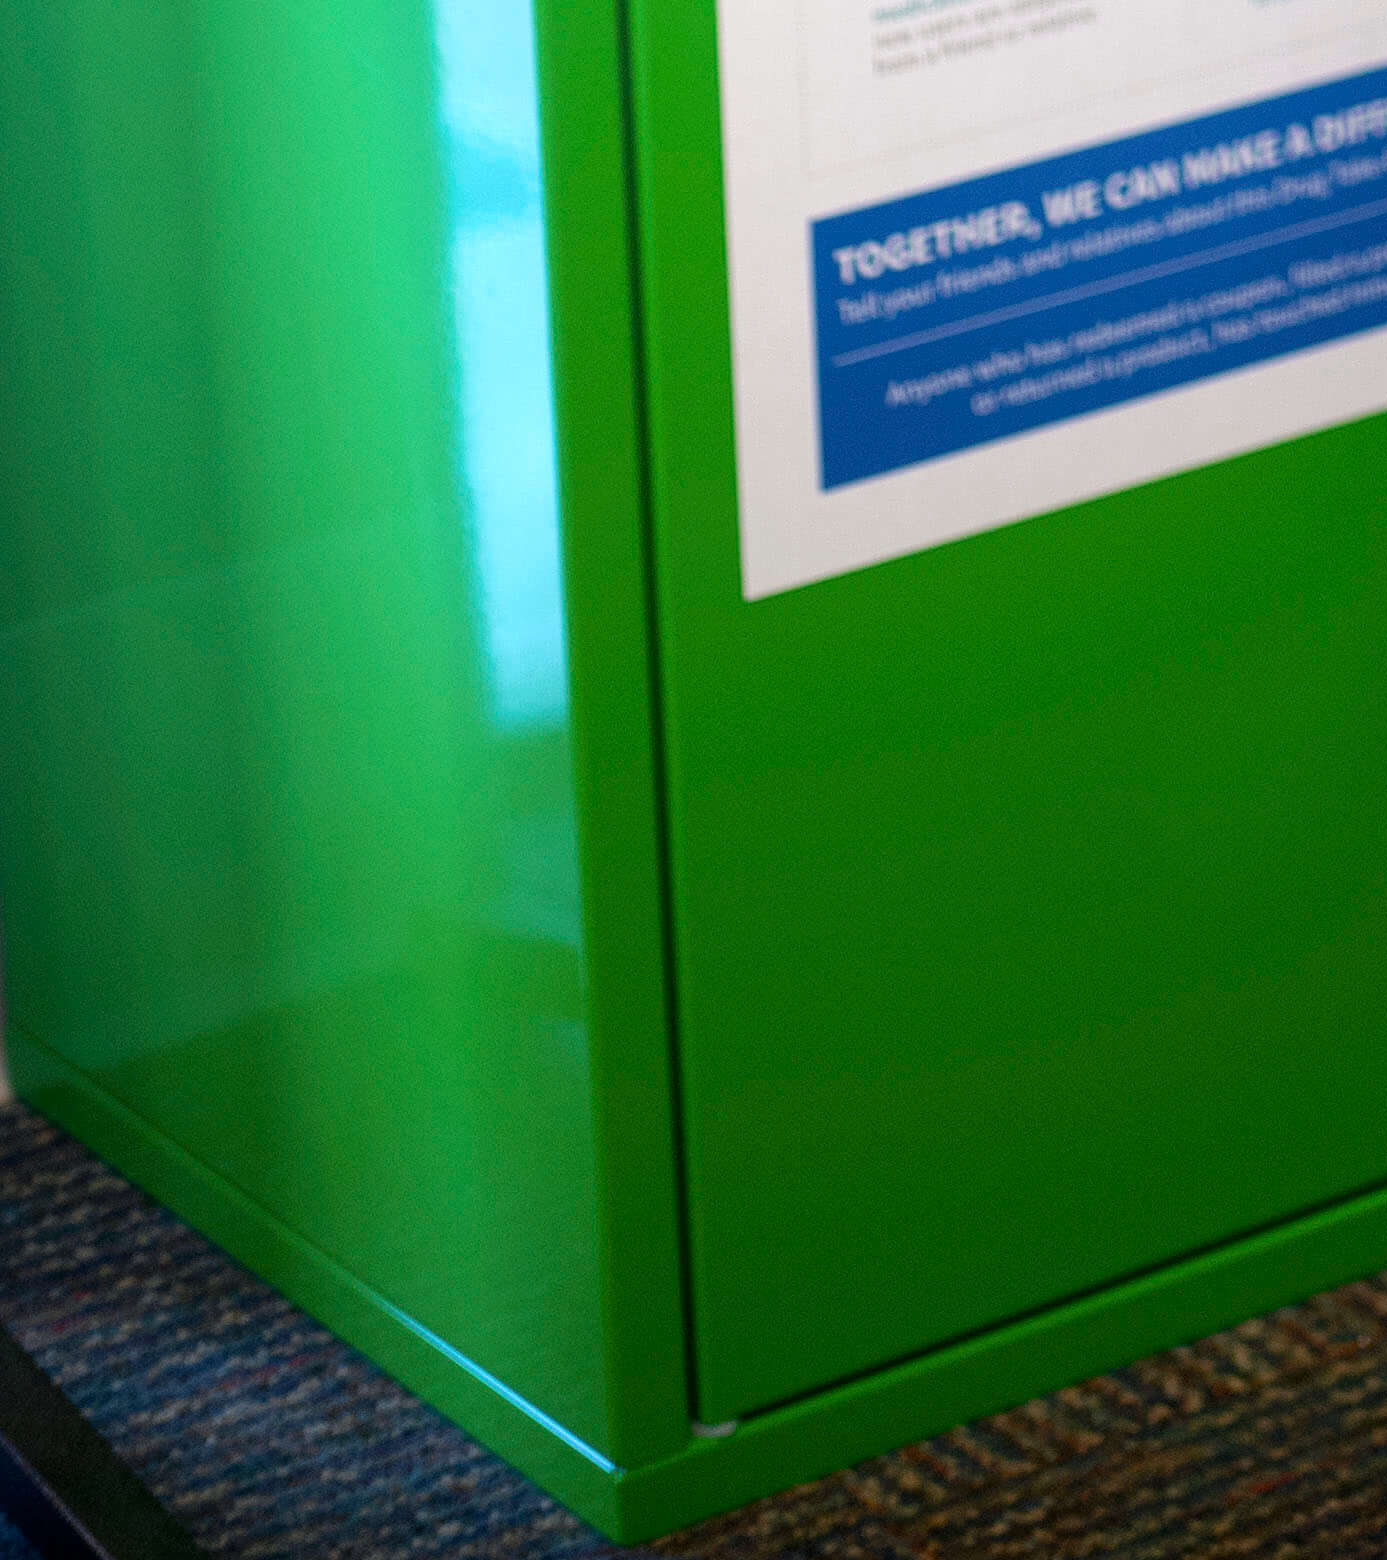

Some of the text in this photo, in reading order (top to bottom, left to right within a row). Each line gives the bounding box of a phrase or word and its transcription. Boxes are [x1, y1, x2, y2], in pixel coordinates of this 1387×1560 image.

[832, 203, 1043, 286] TOGETHER,
[1043, 180, 1103, 228] WE
[1104, 158, 1181, 211] CAN
[1184, 130, 1285, 189] MAKE
[1286, 121, 1315, 161] A
